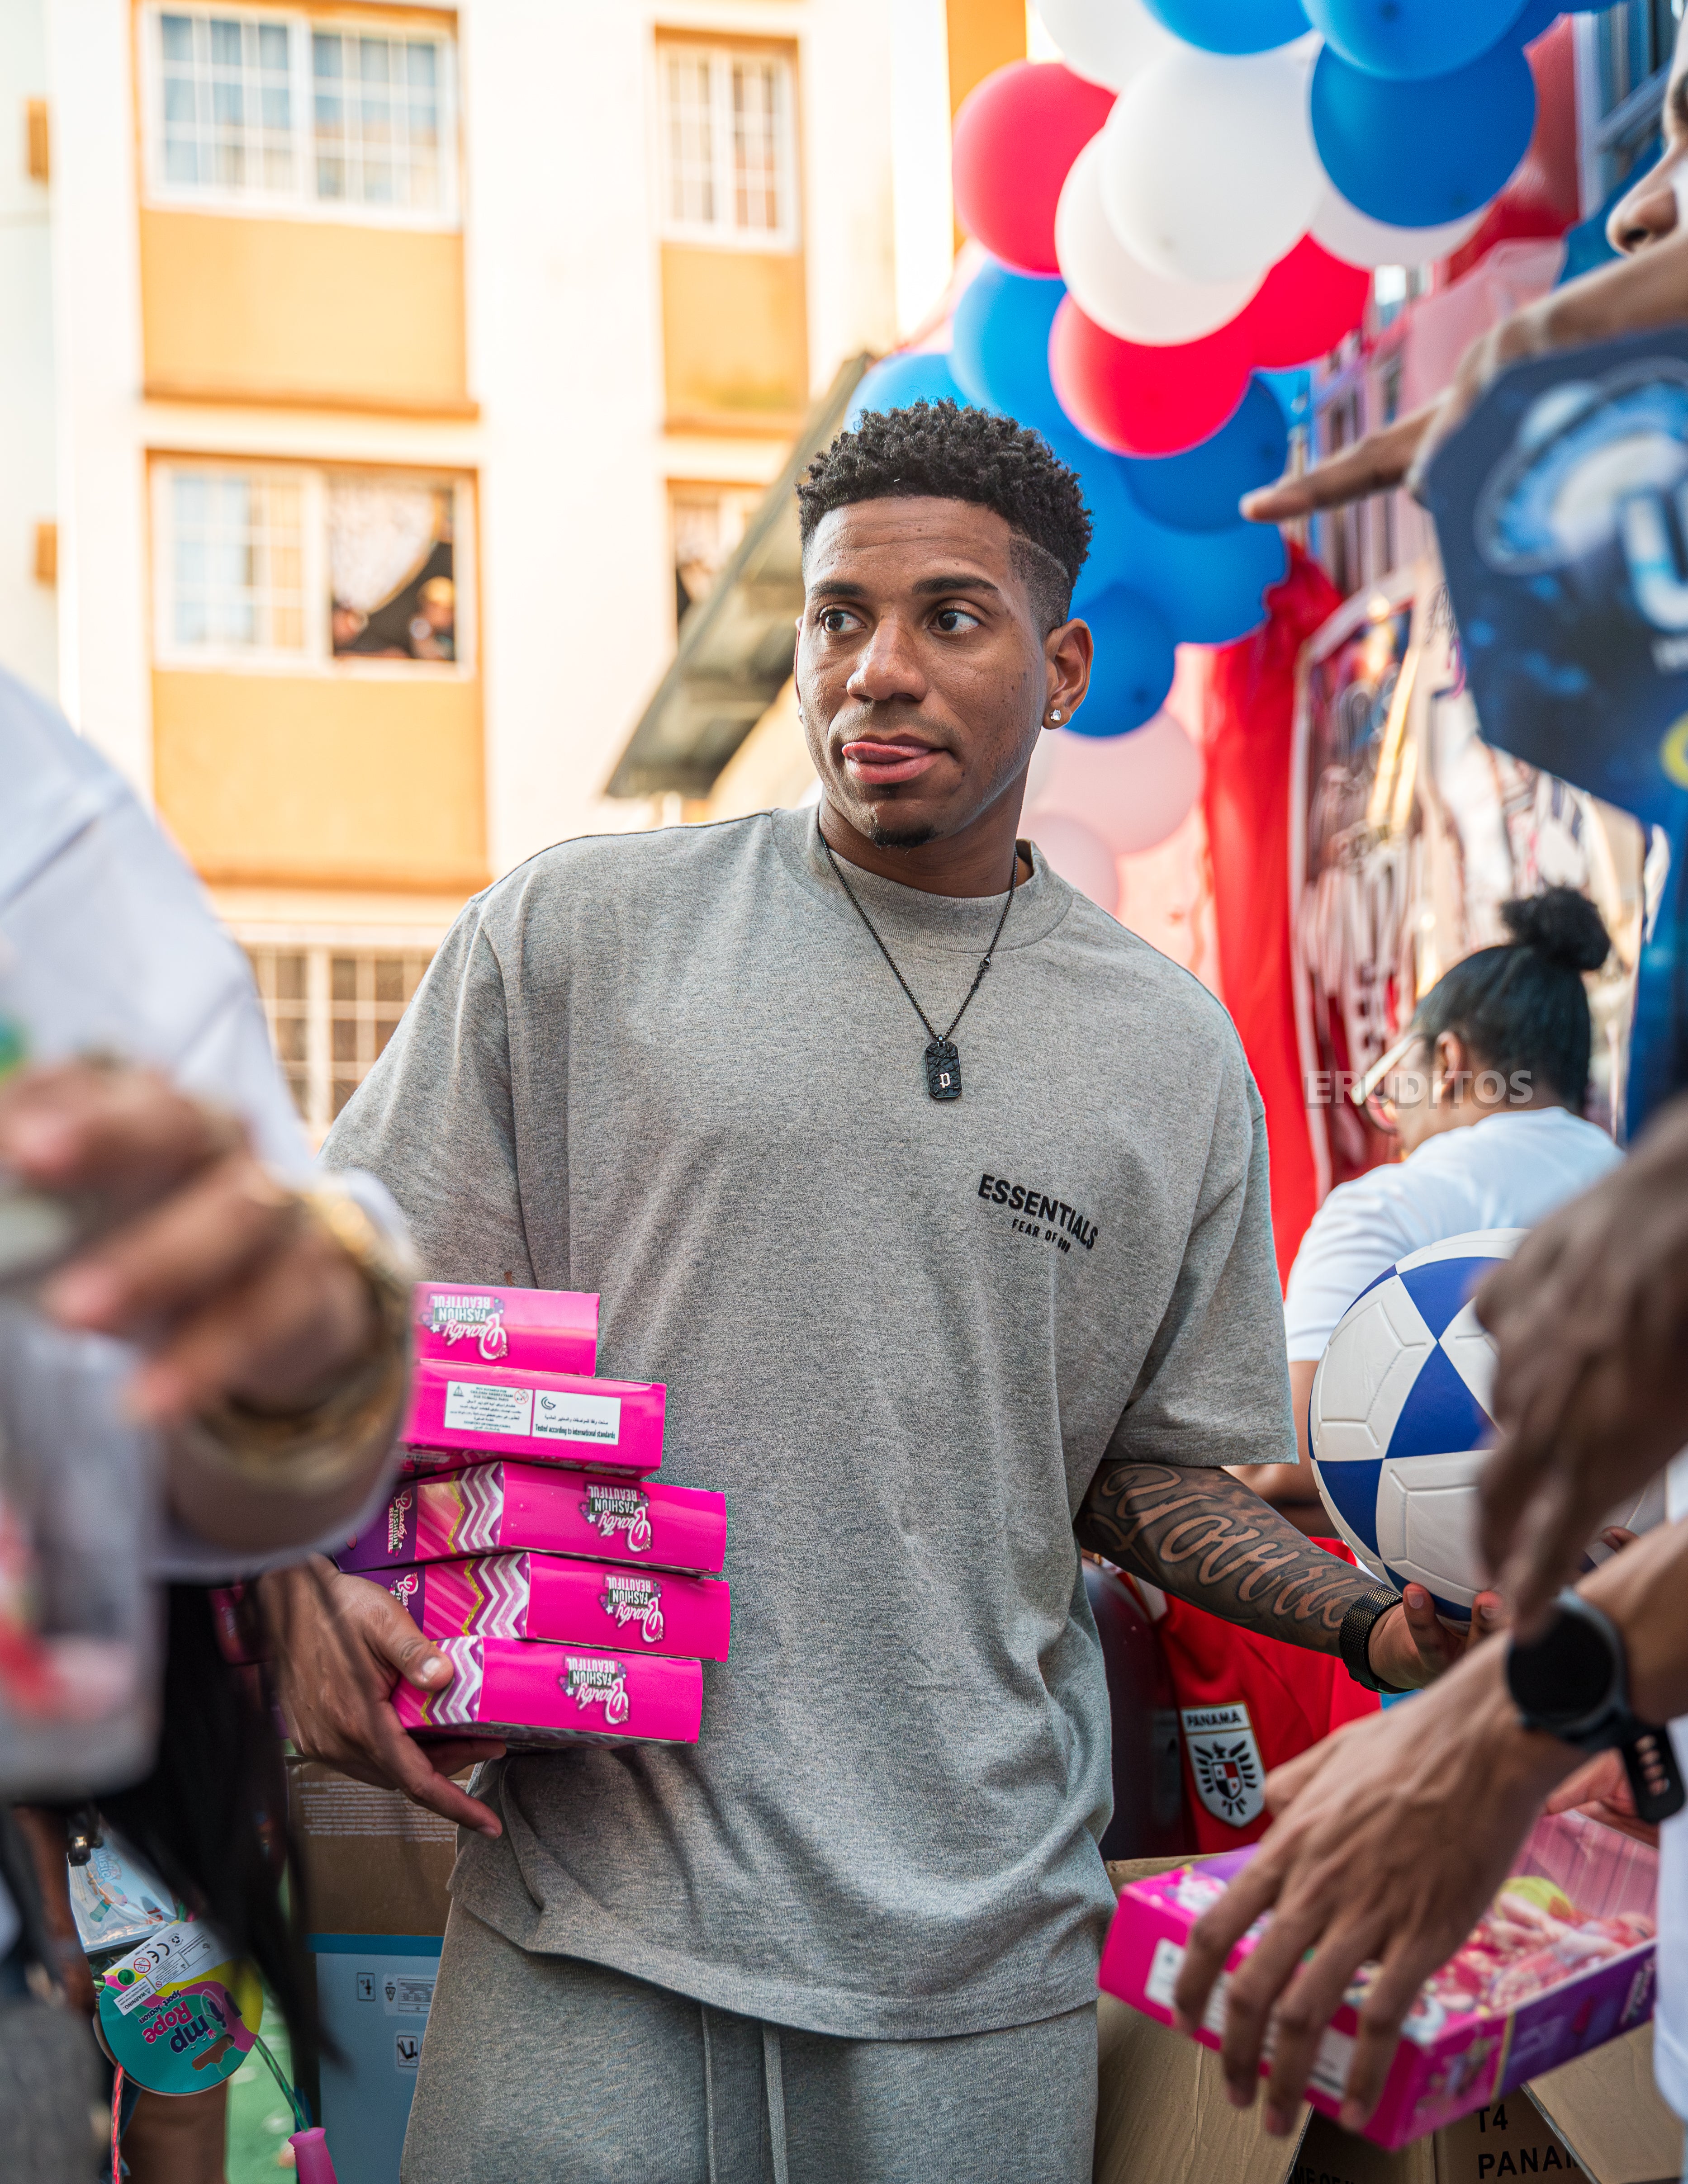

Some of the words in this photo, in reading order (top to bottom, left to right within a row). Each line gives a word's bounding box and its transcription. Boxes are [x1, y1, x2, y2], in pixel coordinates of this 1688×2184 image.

[978, 1174, 1099, 1250] ESSENTIALS
[1012, 1218, 1039, 1238] FEAR
[1044, 1229, 1057, 1243] OF
[432, 1295, 490, 1309] BEAUTIFUL
[535, 1424, 548, 1432] Tested
[549, 1425, 567, 1436] according
[572, 1428, 596, 1437] international
[597, 1430, 616, 1439] standards
[588, 1486, 638, 1502] BEAUTIFUL
[607, 1577, 651, 1593] BEAUTIFUL
[567, 1658, 615, 1674] BEAUTIFUL
[1186, 1709, 1241, 1727] PANAMA
[162, 1990, 181, 2007] Sport
[138, 2004, 163, 2025] Season
[142, 2000, 194, 2044] Rope
